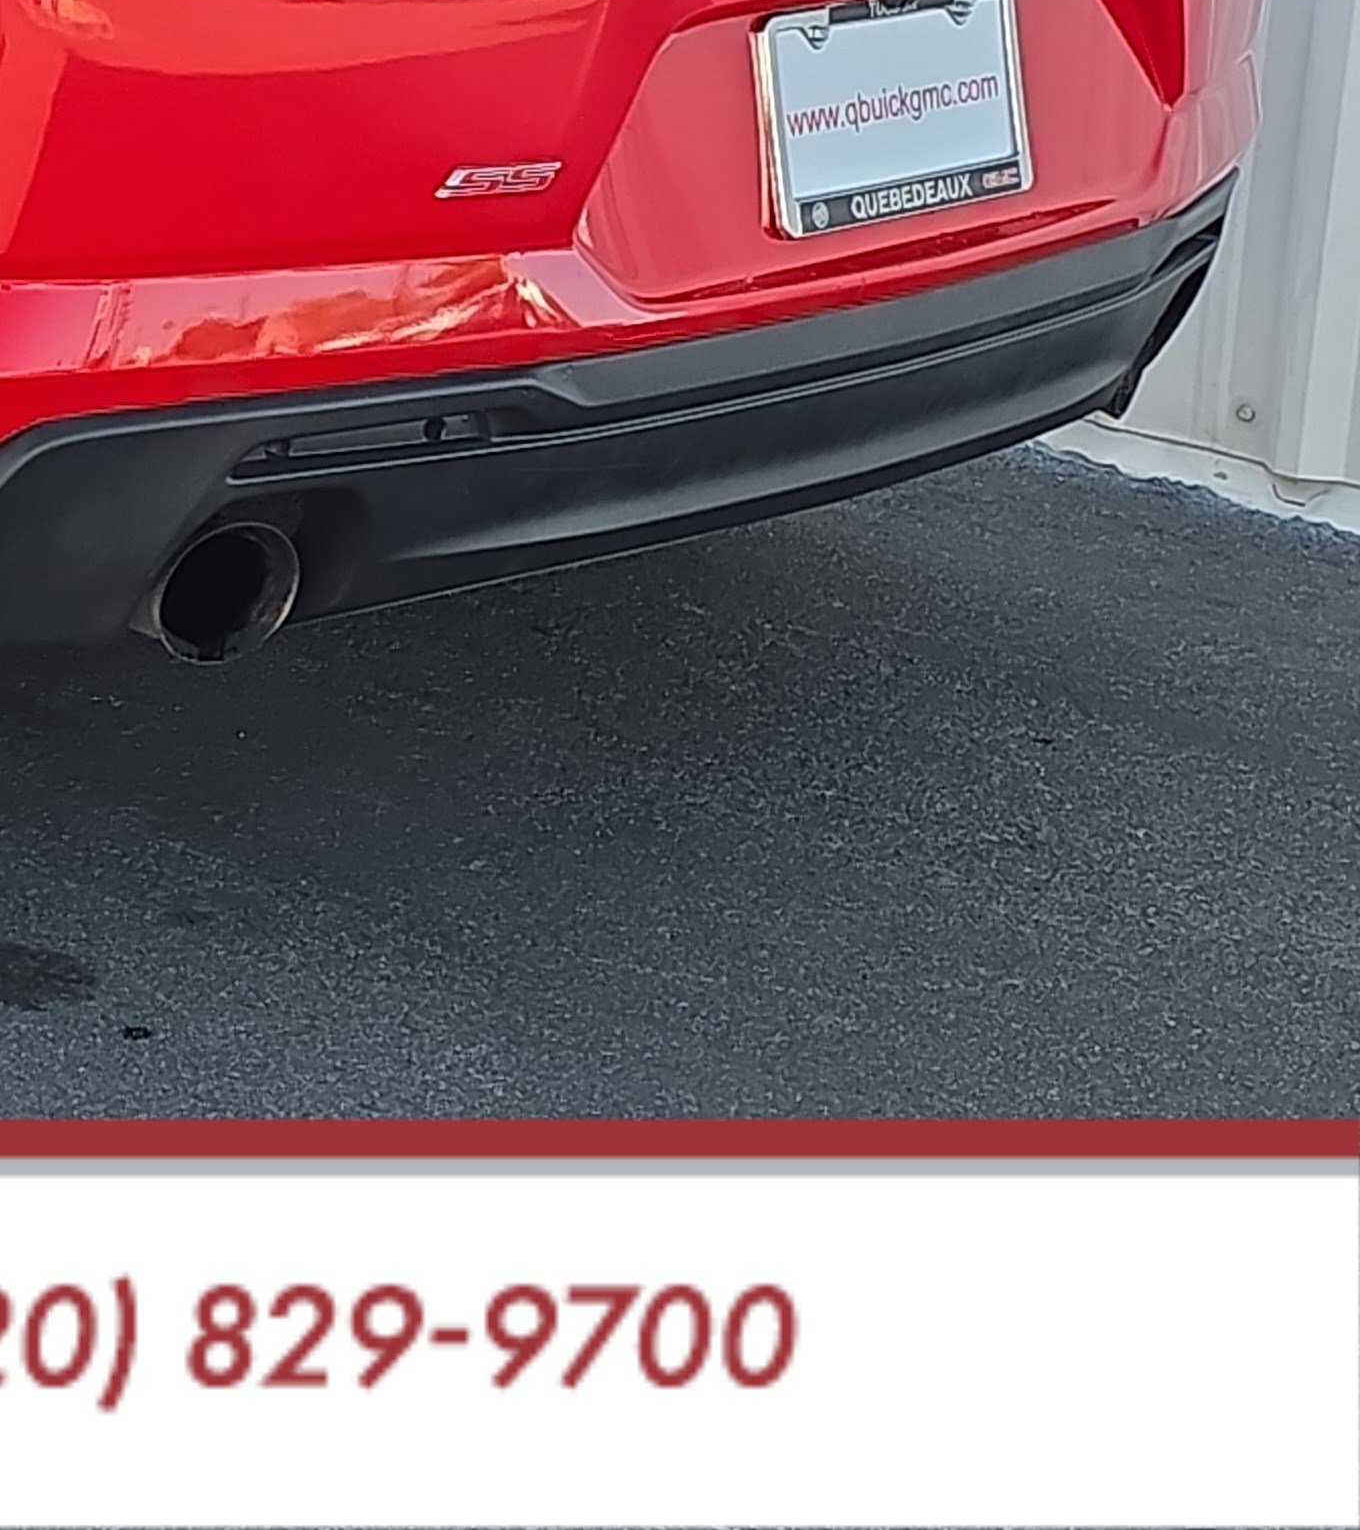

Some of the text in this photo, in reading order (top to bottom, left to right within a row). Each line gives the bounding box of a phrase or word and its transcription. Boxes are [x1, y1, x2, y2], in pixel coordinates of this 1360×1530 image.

[785, 74, 999, 137] www.qbuickgmc.com
[434, 161, 562, 198] SS
[850, 173, 973, 219] QUEBEDEAUX
